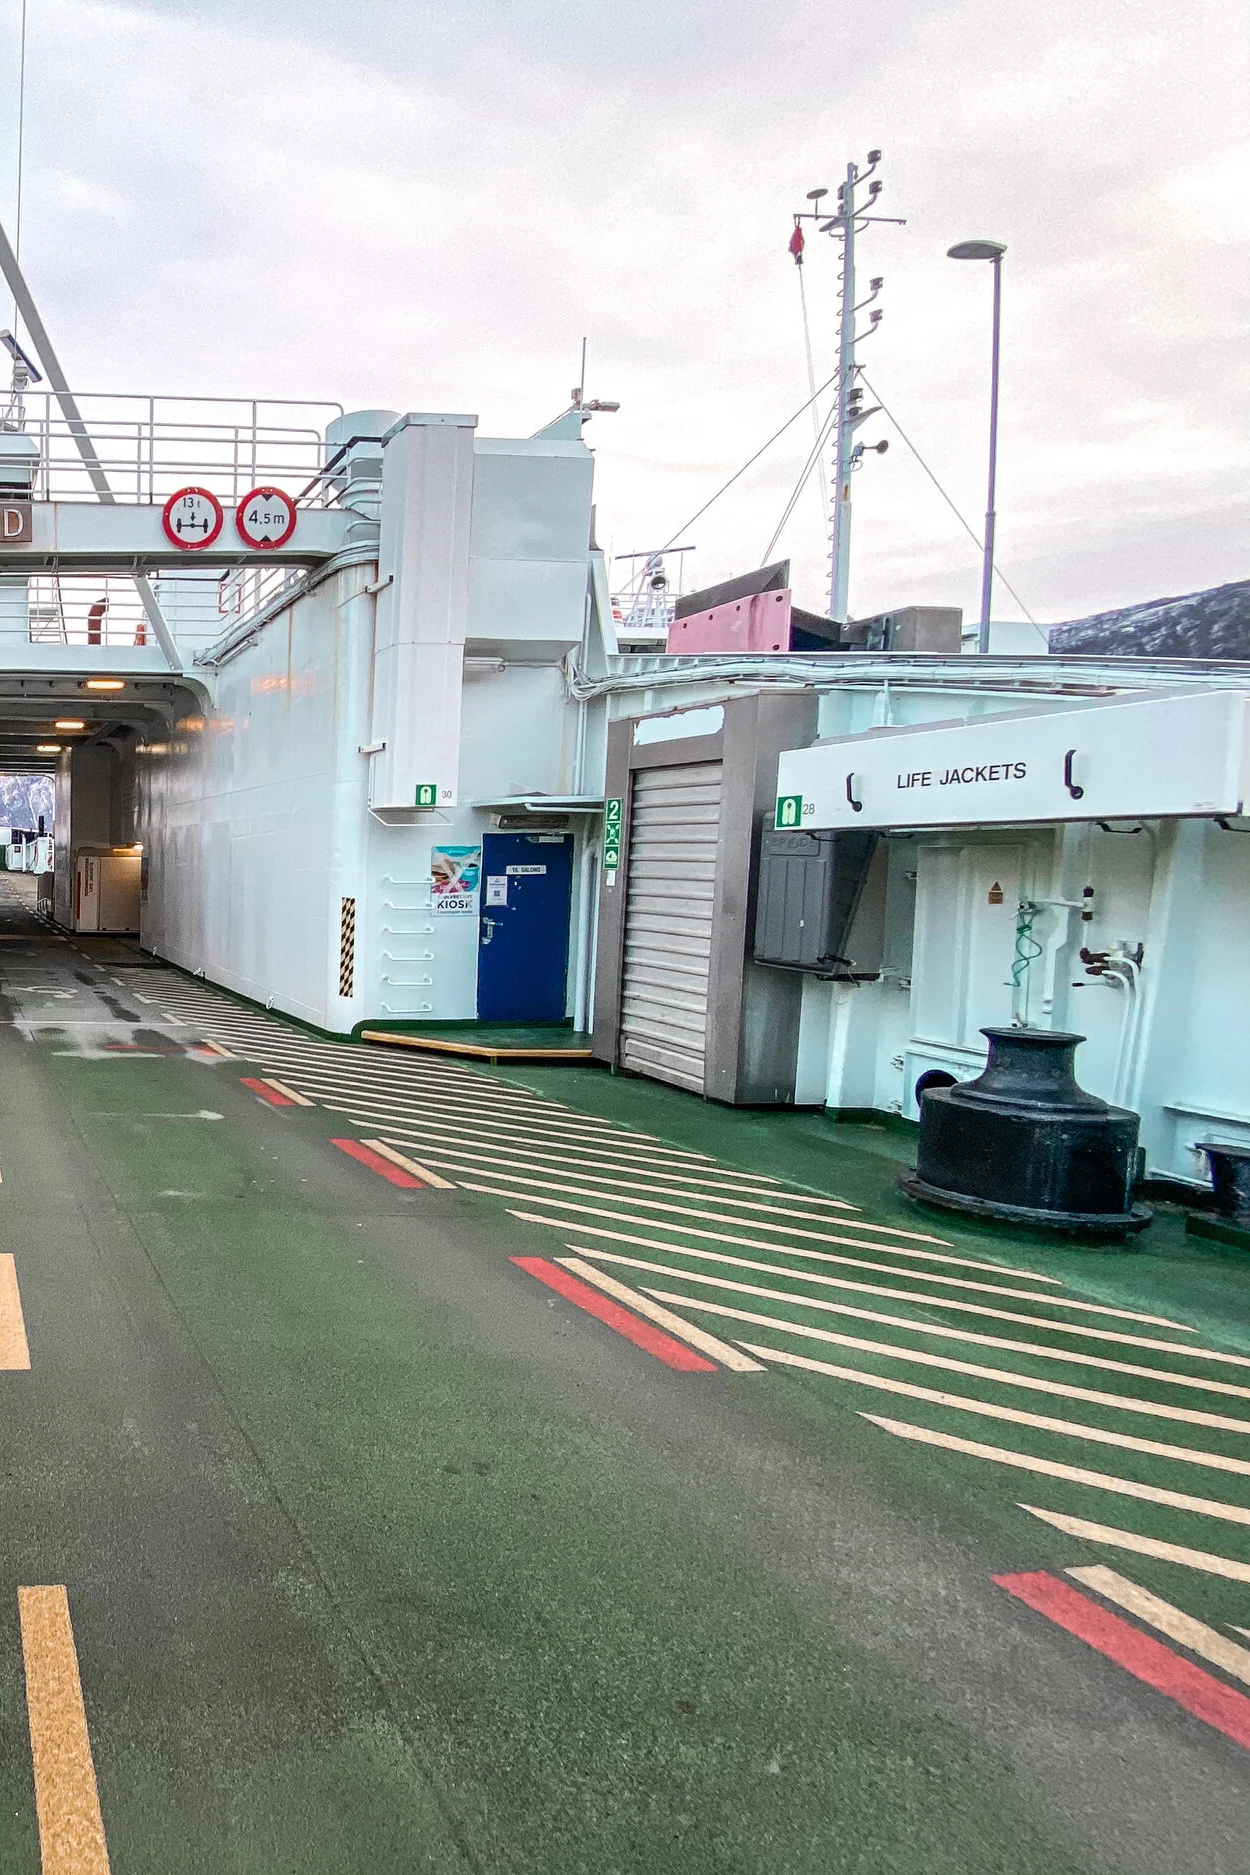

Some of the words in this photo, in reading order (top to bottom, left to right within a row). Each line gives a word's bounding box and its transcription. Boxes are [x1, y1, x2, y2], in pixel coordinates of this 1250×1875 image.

[183, 497, 194, 508] 13
[249, 510, 270, 525] 4,5
[273, 514, 285, 524] m
[897, 772, 932, 789] LIFE
[939, 762, 1027, 786] JACKETS
[441, 790, 452, 799] 30
[609, 801, 619, 820] 2
[802, 804, 815, 815] 28
[437, 900, 473, 909] KIOSK
